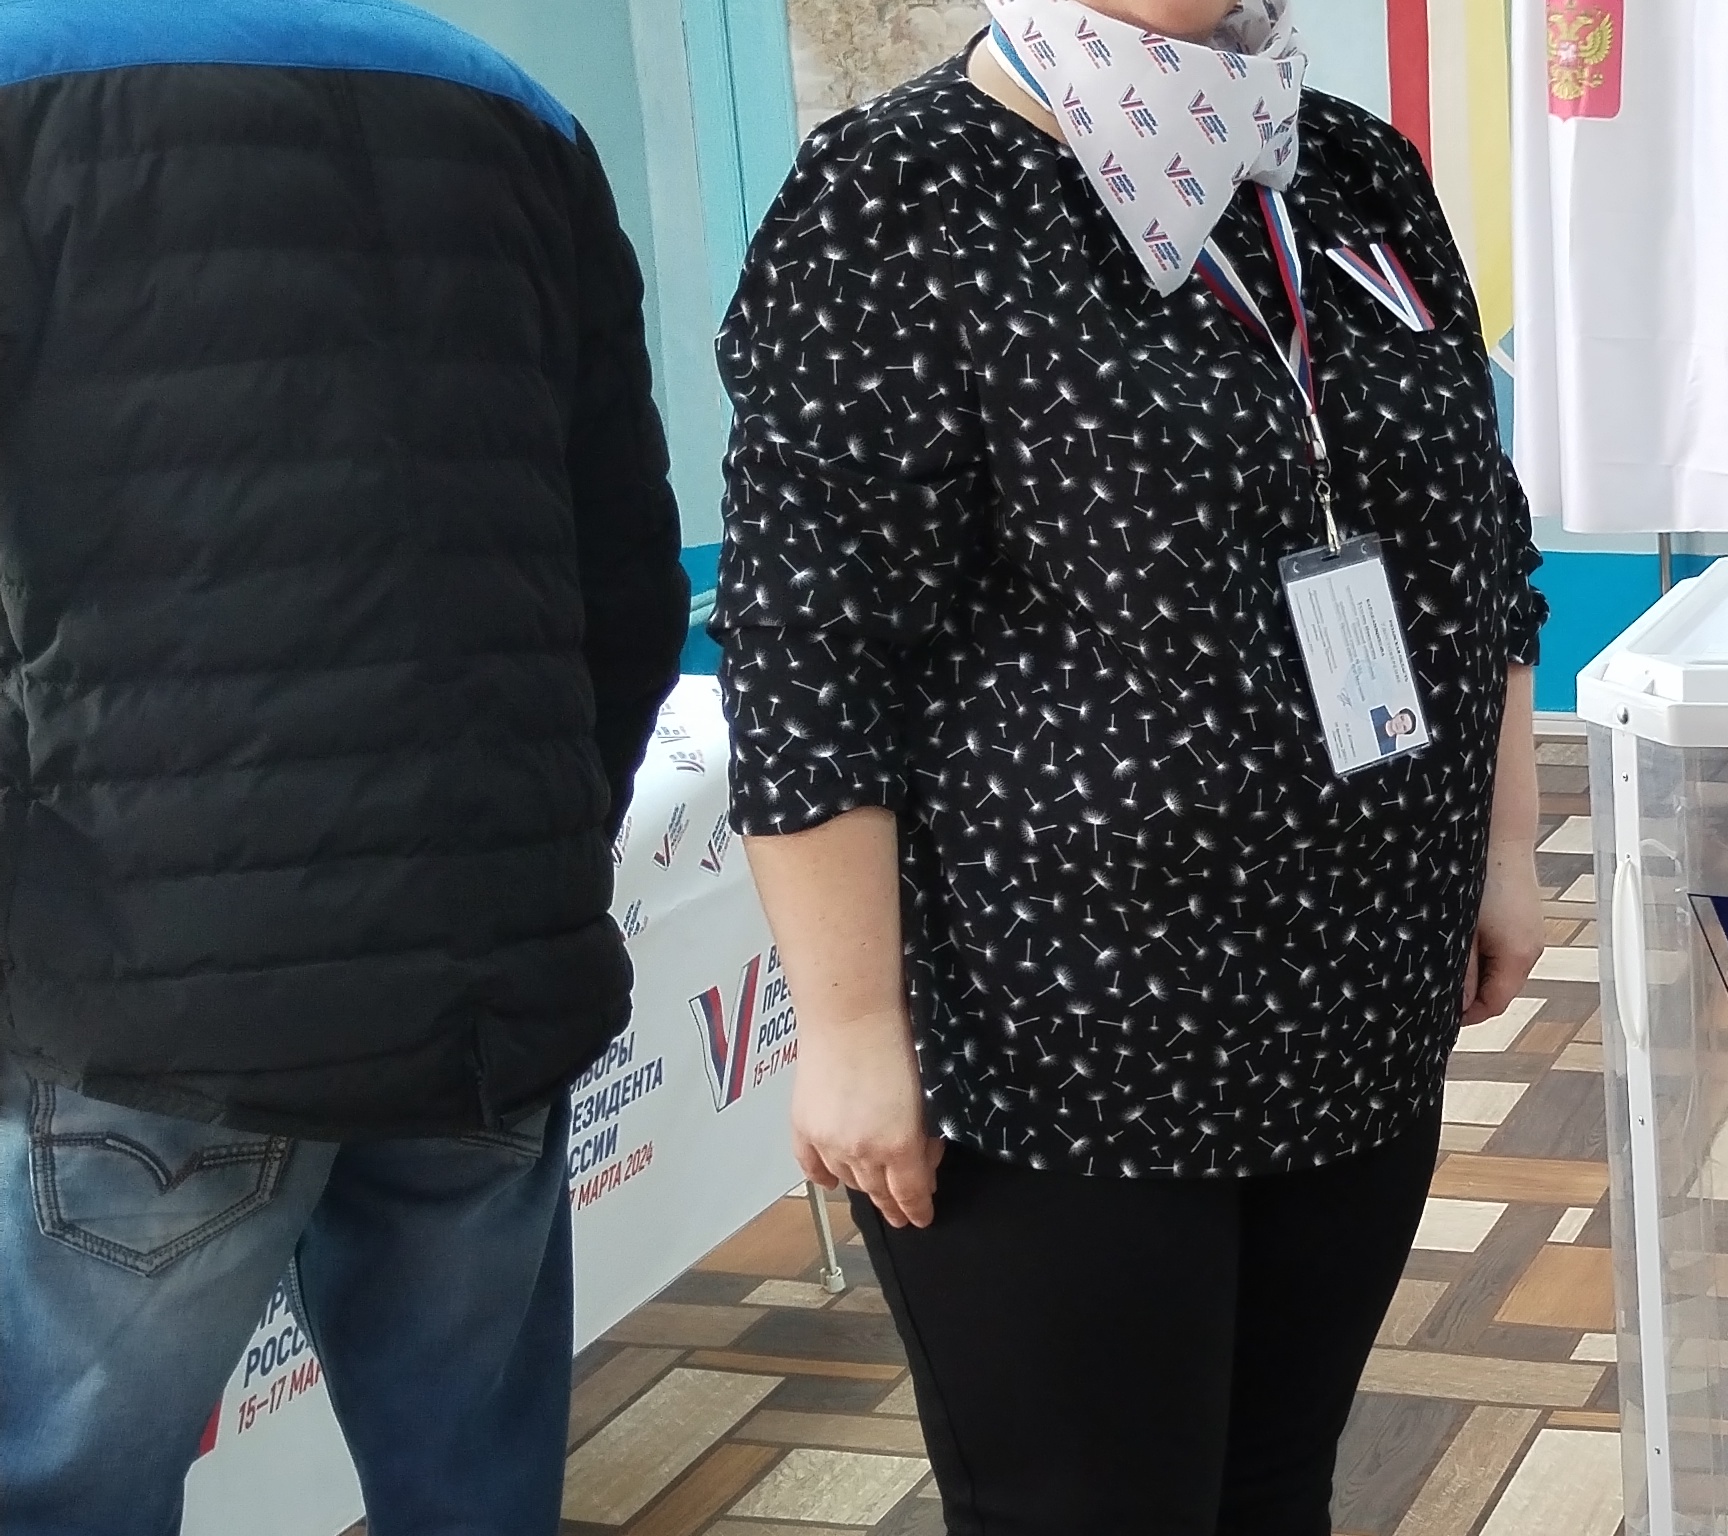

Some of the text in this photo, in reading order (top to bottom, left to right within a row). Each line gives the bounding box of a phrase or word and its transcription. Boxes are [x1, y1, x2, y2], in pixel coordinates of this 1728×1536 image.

[757, 1007, 797, 1054] РОСС
[781, 1039, 798, 1070] МА
[571, 1056, 663, 1136] ЕЗИДЕНТА
[568, 1123, 618, 1181] ССИИ
[577, 1161, 622, 1210] МАРТА
[624, 1140, 653, 1182] 2024
[243, 1326, 305, 1389] РОСС
[288, 1357, 321, 1402] МА
